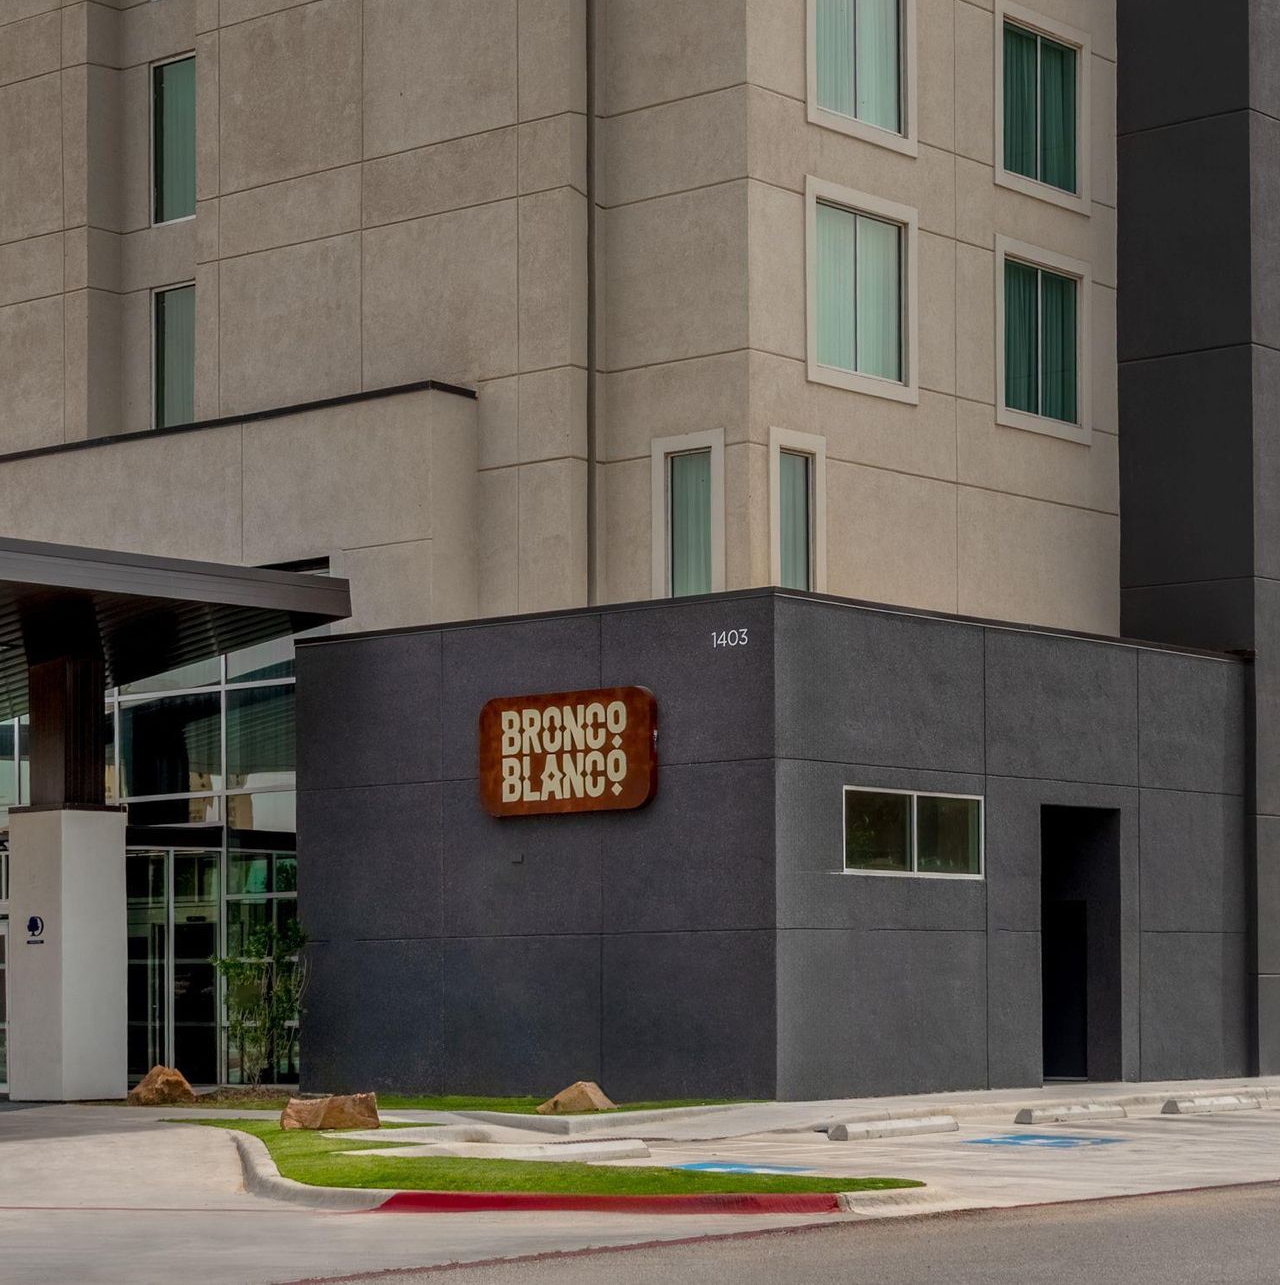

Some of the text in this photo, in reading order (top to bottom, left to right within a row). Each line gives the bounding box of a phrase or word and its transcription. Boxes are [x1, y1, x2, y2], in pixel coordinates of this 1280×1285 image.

[710, 628, 749, 648] 1403
[501, 700, 627, 756] BRONCO
[501, 749, 627, 803] BLANCO
